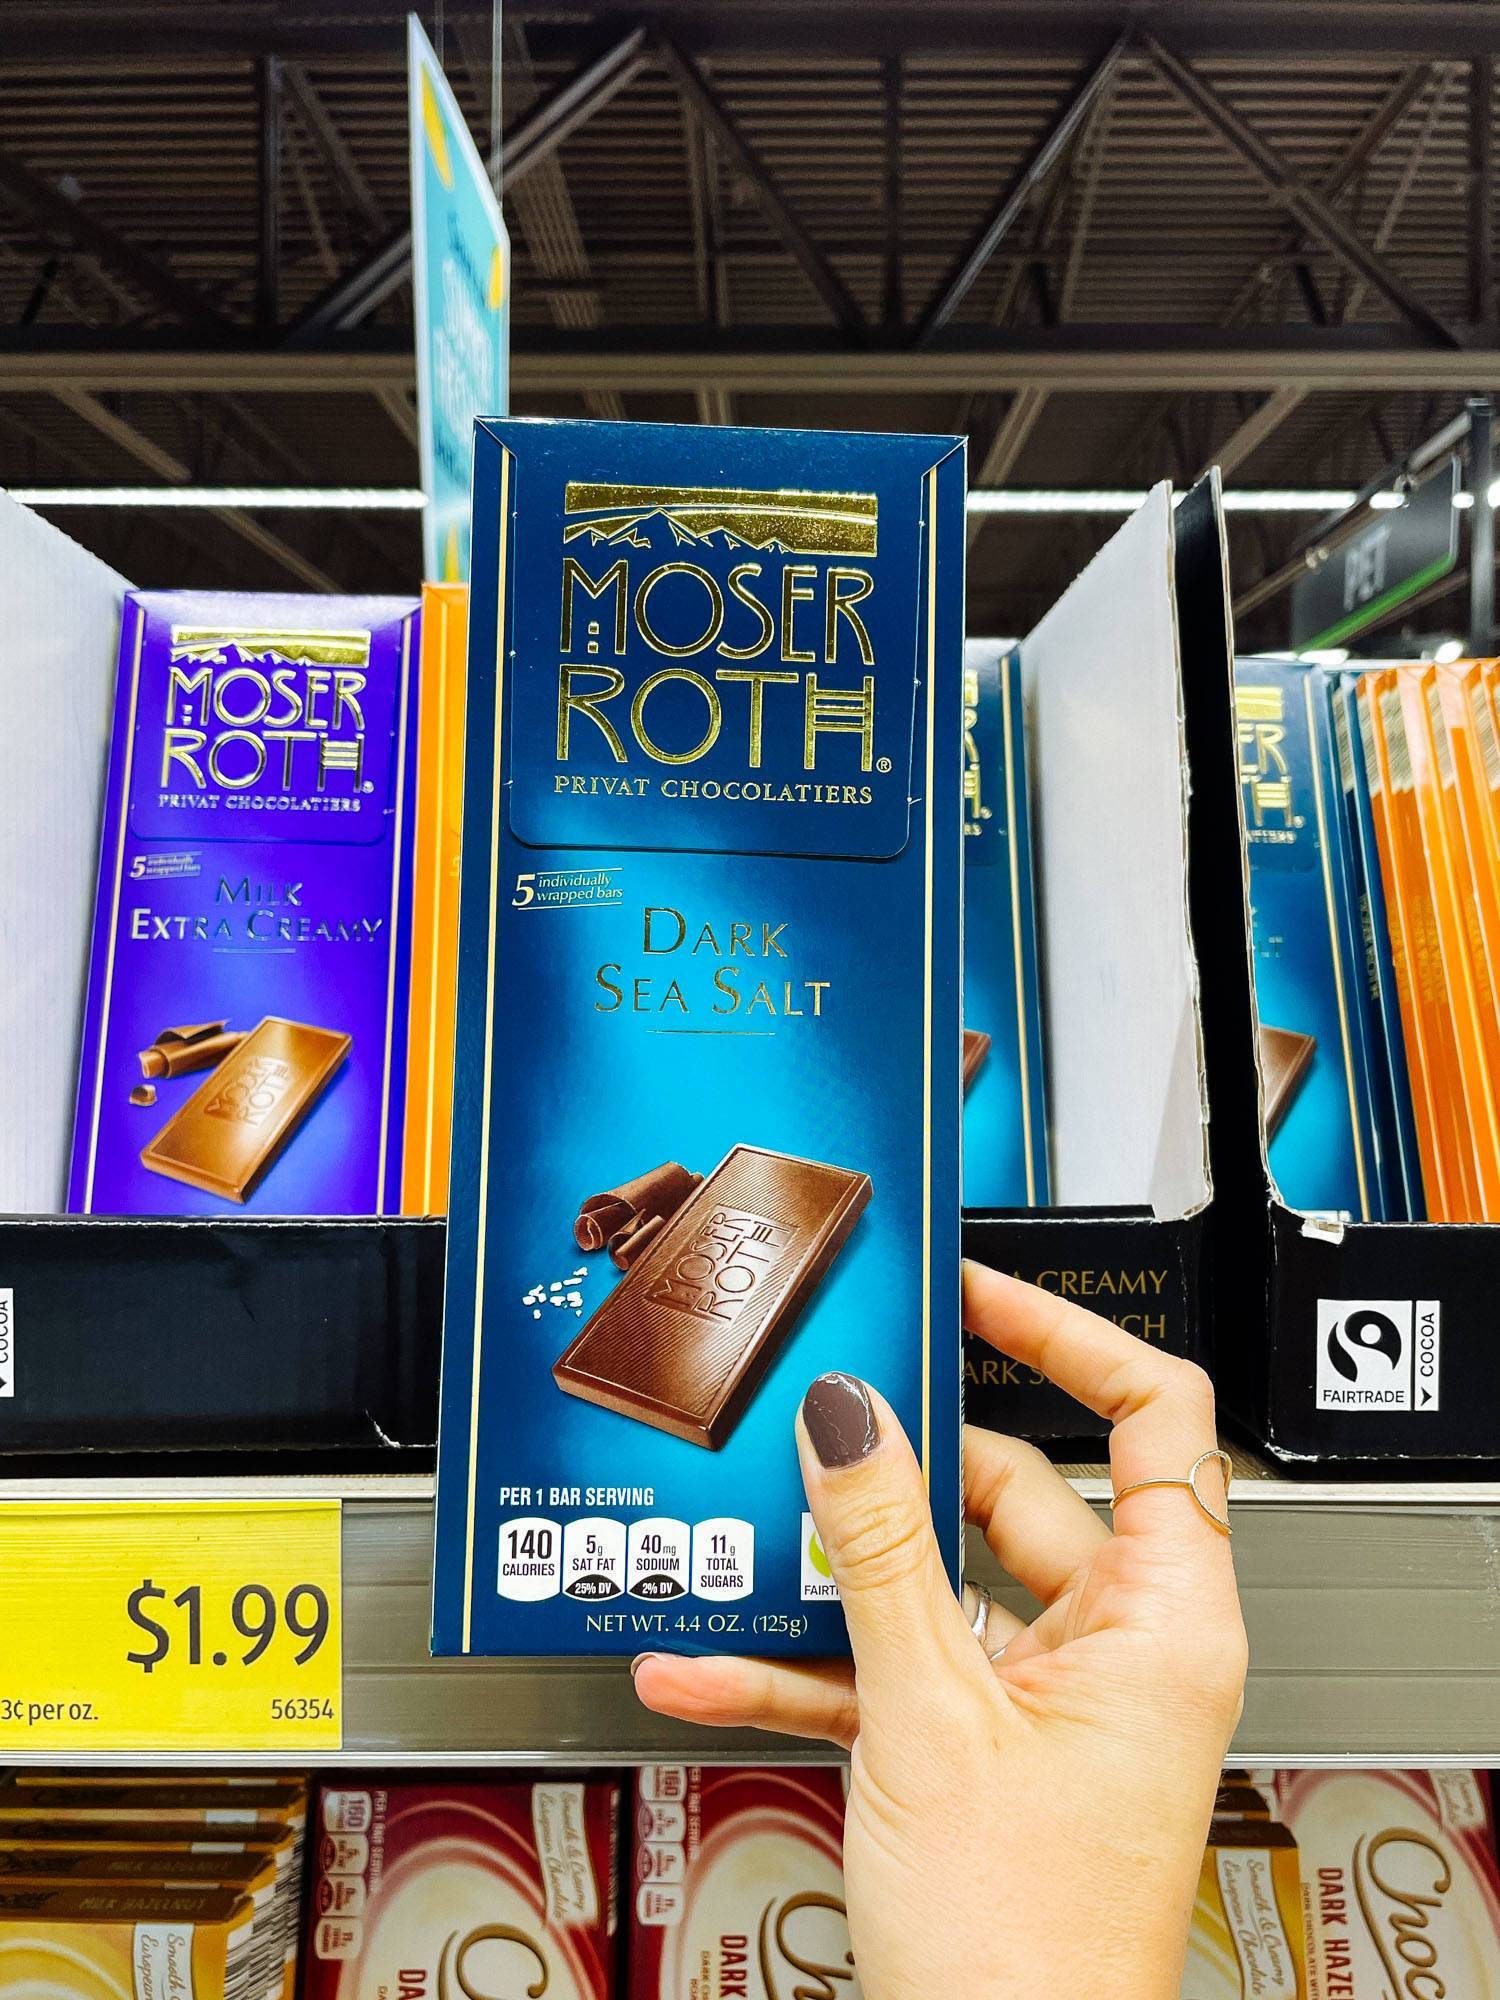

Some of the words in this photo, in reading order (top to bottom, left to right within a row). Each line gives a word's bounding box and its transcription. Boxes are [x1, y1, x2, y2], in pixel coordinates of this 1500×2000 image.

[561, 558, 875, 665] MOSER
[165, 667, 366, 730] MOSER
[159, 794, 220, 809] PRIVAT
[225, 795, 361, 812] CHOCOLATIERS
[553, 775, 650, 799] PRIVAT
[660, 779, 873, 805] CHOCOLATIERS
[130, 856, 146, 878] 5
[215, 873, 303, 906] MILK
[512, 873, 535, 906] 5
[538, 872, 612, 889] individually
[537, 888, 594, 904] wrapped
[596, 886, 623, 899] bars
[131, 908, 231, 940] EXTRA
[247, 909, 382, 942] CREAMY
[643, 906, 790, 957] DARK
[594, 963, 690, 1013] SEA
[711, 966, 831, 1016] SALT
[653, 1212, 752, 1311] MOSER
[693, 1219, 791, 1320] ROTH
[1036, 1270, 1168, 1296] CREAMY
[1421, 1312, 1435, 1377] COCOA
[964, 1360, 1020, 1385] ARK
[1323, 1389, 1404, 1403] FAIRTRADE
[499, 1487, 531, 1506] PER
[535, 1489, 543, 1506] 1
[549, 1487, 581, 1506] BAR
[585, 1487, 654, 1506] SERVING
[508, 1529, 552, 1560] 140
[502, 1563, 555, 1577] CALORIES
[572, 1558, 592, 1571] SAT
[596, 1558, 616, 1571] FAT
[636, 1558, 680, 1571] SODIUM
[705, 1558, 739, 1571] TOTAL
[574, 1582, 596, 1595] 25%
[598, 1581, 612, 1594] DV
[642, 1582, 657, 1595] 2%
[659, 1581, 673, 1595] DV
[700, 1575, 743, 1588] SUGARS
[127, 1579, 330, 1673] $1.99
[586, 1615, 627, 1633] NET
[631, 1615, 669, 1633] WT.
[674, 1615, 701, 1633] 4.4
[707, 1615, 745, 1633] OZ.
[752, 1614, 808, 1639] (125g)
[28, 1703, 65, 1726] per
[69, 1703, 99, 1721] oz.
[271, 1699, 335, 1720] 56354
[1318, 1867, 1347, 1925] DARK
[720, 1935, 749, 1998] DARK
[1324, 1938, 1356, 2000] HAZE
